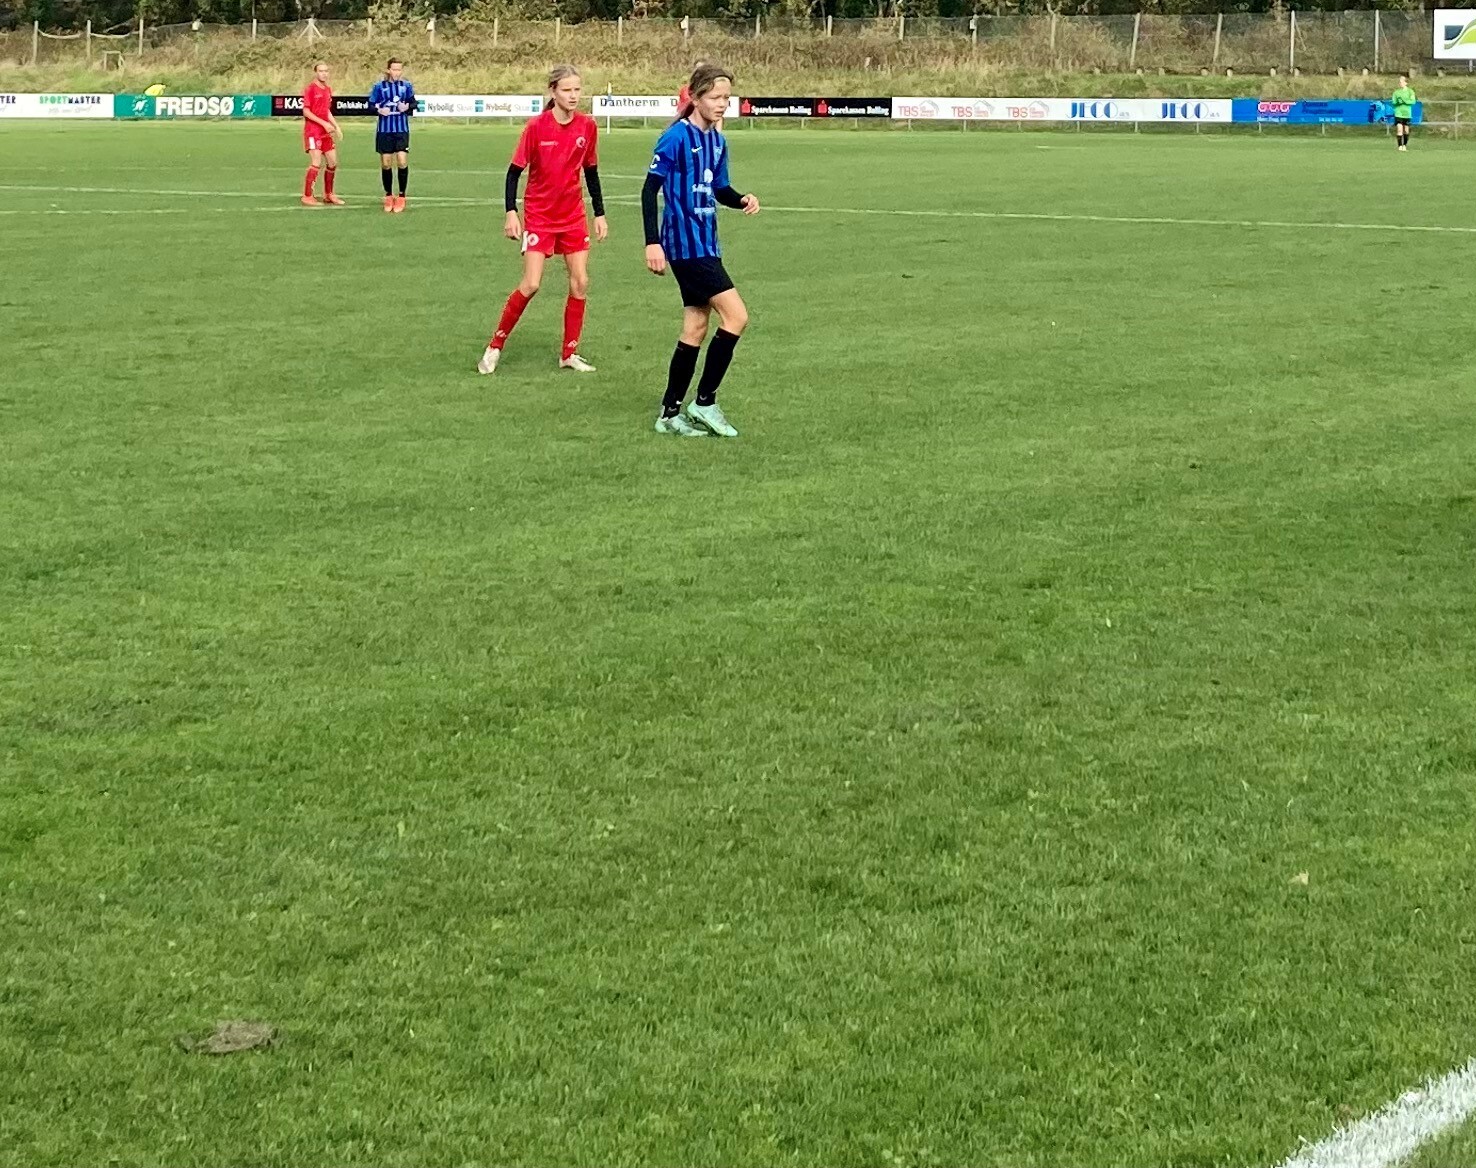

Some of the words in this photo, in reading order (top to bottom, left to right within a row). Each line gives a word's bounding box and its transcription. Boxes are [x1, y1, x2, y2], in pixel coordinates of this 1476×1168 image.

[39, 95, 101, 104] SPORTMASTER
[155, 96, 235, 116] FREDSØ
[898, 106, 919, 117] TBS
[951, 106, 973, 118] TBS
[1005, 107, 1028, 118] TBS
